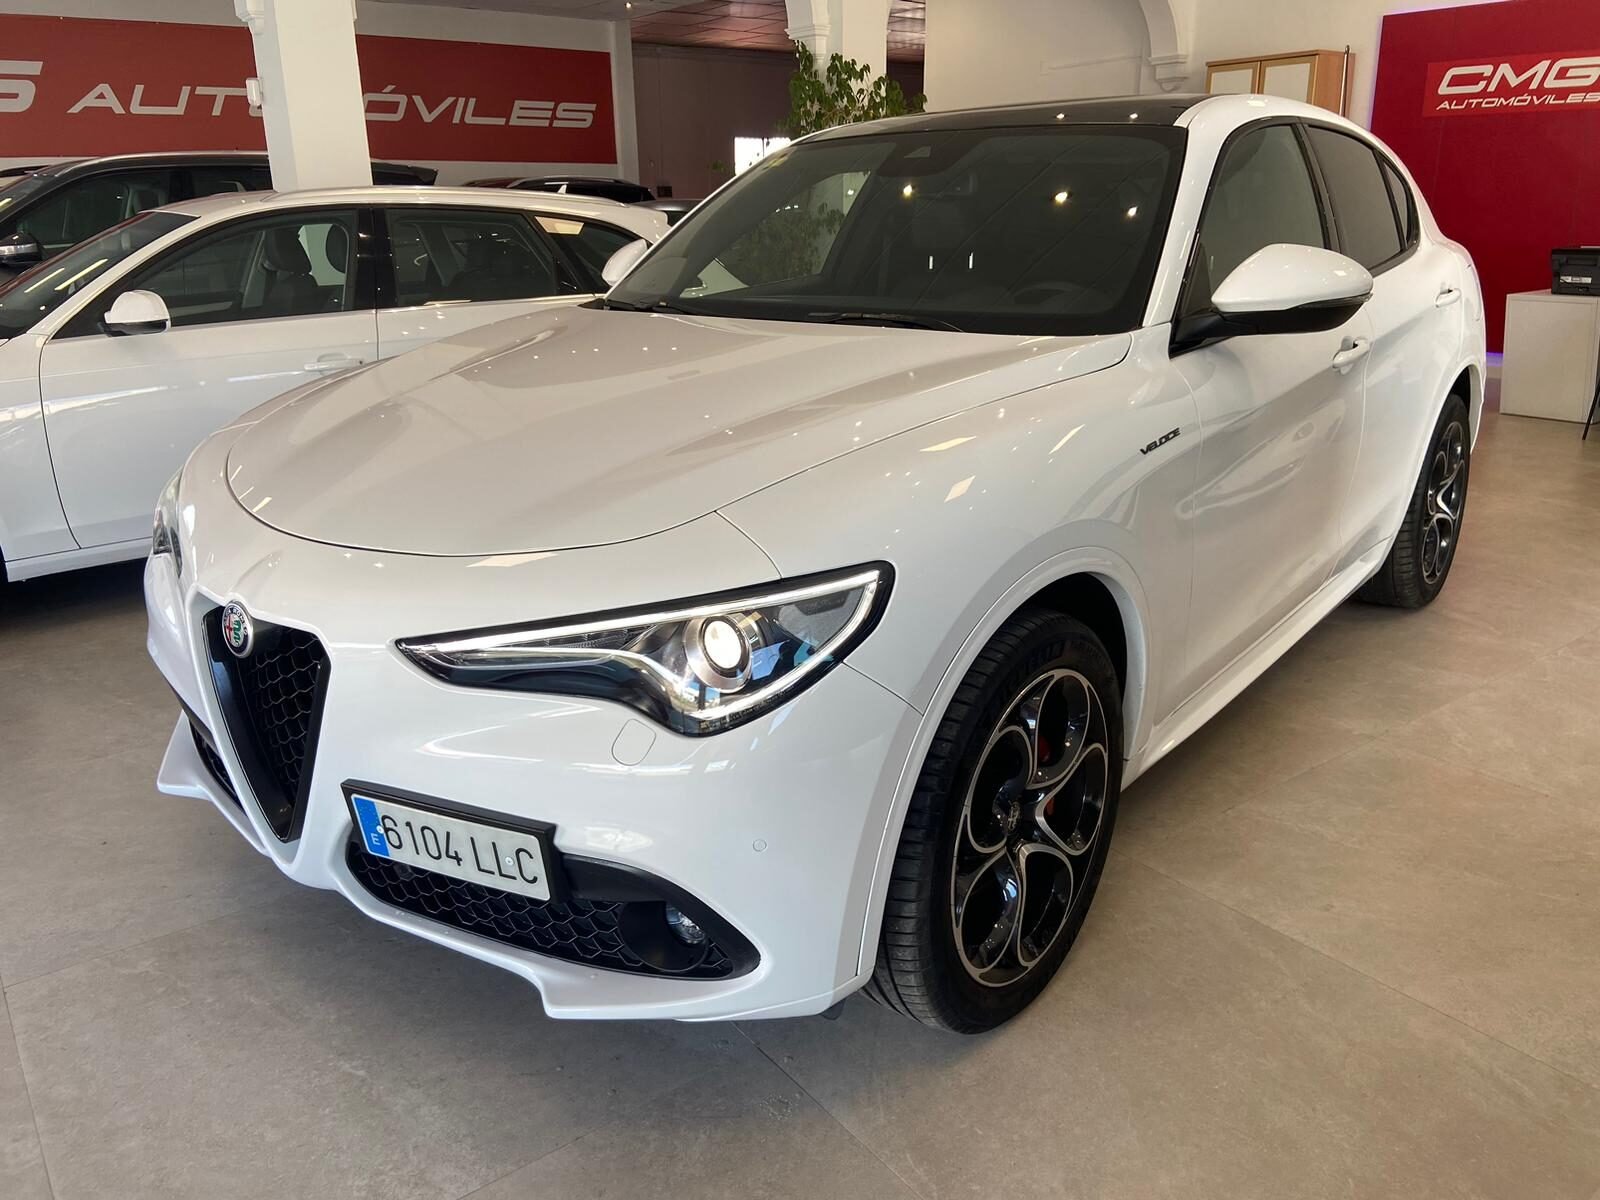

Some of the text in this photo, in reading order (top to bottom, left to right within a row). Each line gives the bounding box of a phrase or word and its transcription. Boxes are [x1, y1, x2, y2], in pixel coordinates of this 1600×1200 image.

[1437, 56, 1600, 96] CMG
[1436, 92, 1600, 111] AUTOMÓVILES
[1140, 427, 1181, 455] VELOCE
[370, 814, 538, 885] E 6104 LLC
